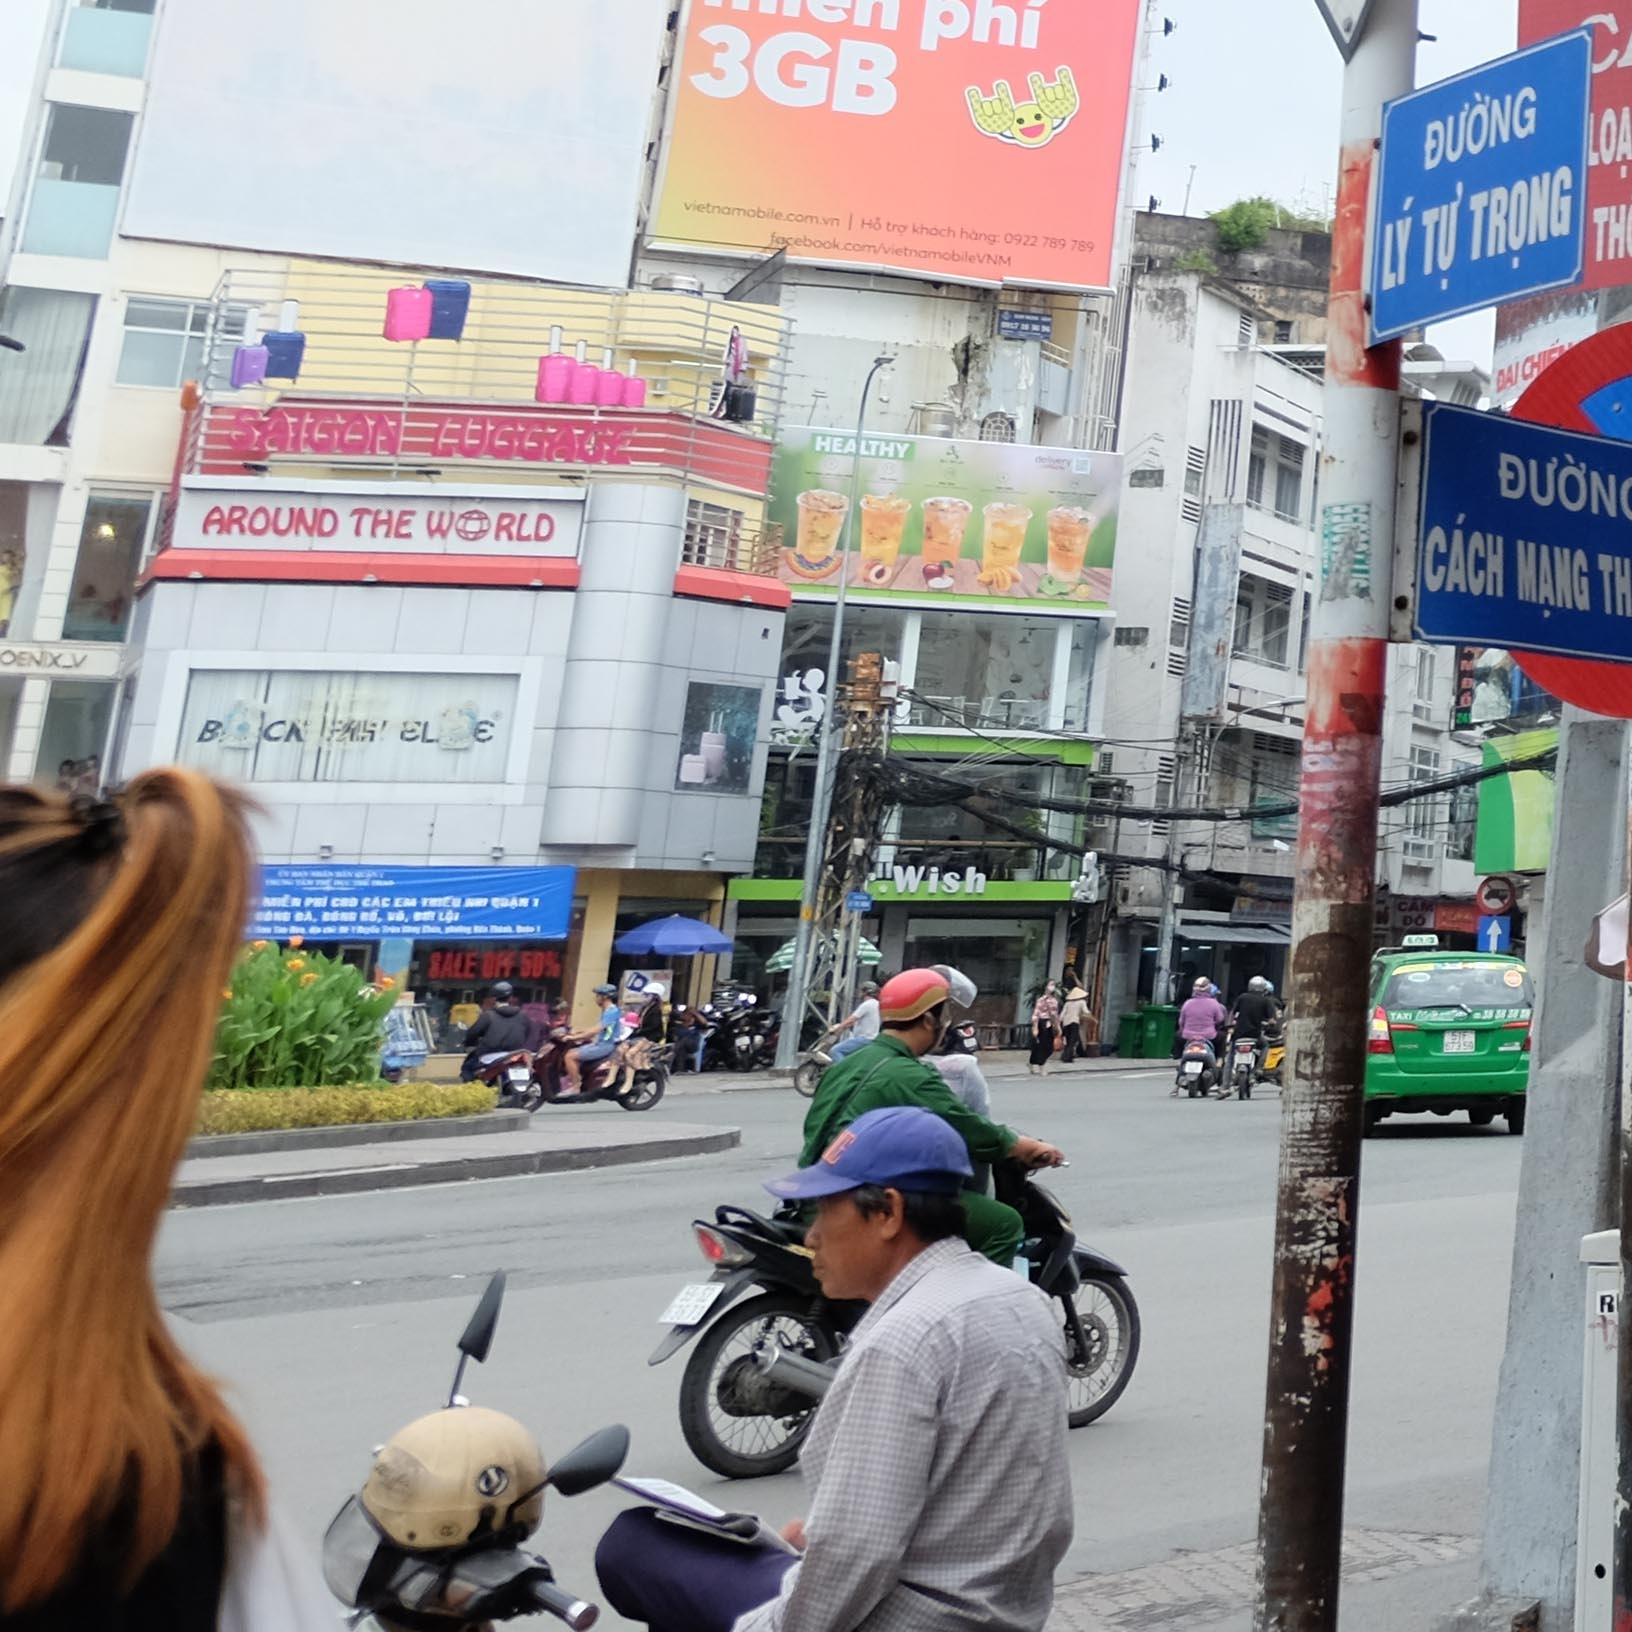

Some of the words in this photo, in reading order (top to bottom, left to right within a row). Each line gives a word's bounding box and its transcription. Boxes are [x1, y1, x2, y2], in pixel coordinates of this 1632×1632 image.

[689, 24, 898, 117] 3GB
[1424, 85, 1537, 170] ĐƯỜNG
[684, 200, 841, 227] vietnamobile.com.vn
[912, 222, 956, 239] khách
[1003, 232, 1039, 247] 0922
[1042, 237, 1067, 250] 789
[1070, 240, 1096, 254] 789
[1382, 204, 1412, 292] LÝ
[1421, 183, 1464, 293] TỰ
[1470, 166, 1573, 268] TRỌNG
[815, 436, 910, 459] HEALTHY
[201, 506, 339, 539] AROUND
[349, 507, 415, 539] THE
[1423, 513, 1504, 599] CÁCH
[1517, 542, 1591, 619] MẠNG
[427, 951, 475, 979] SALE
